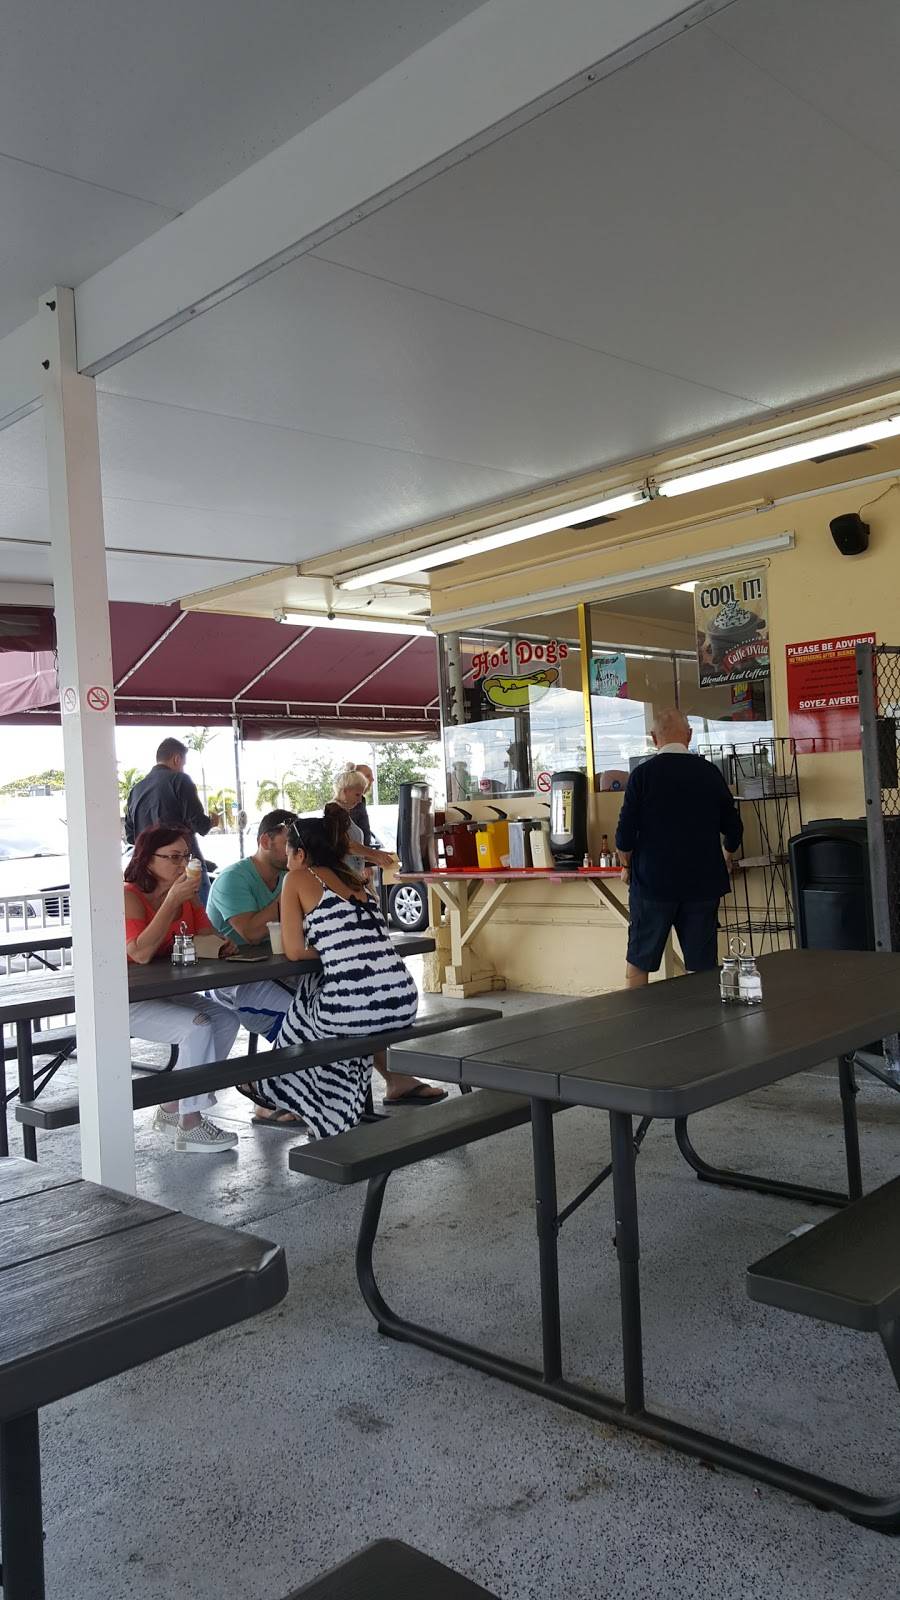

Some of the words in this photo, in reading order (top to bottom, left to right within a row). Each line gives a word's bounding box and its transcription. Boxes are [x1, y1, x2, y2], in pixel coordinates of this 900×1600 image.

[701, 584, 740, 608] COOL
[743, 578, 762, 600] IT!
[787, 644, 819, 656] PLEASE
[822, 642, 833, 651] BE
[472, 648, 509, 680] Hot
[701, 673, 729, 685] Blended
[730, 670, 745, 681] Iced
[799, 698, 827, 709] SOYEZ
